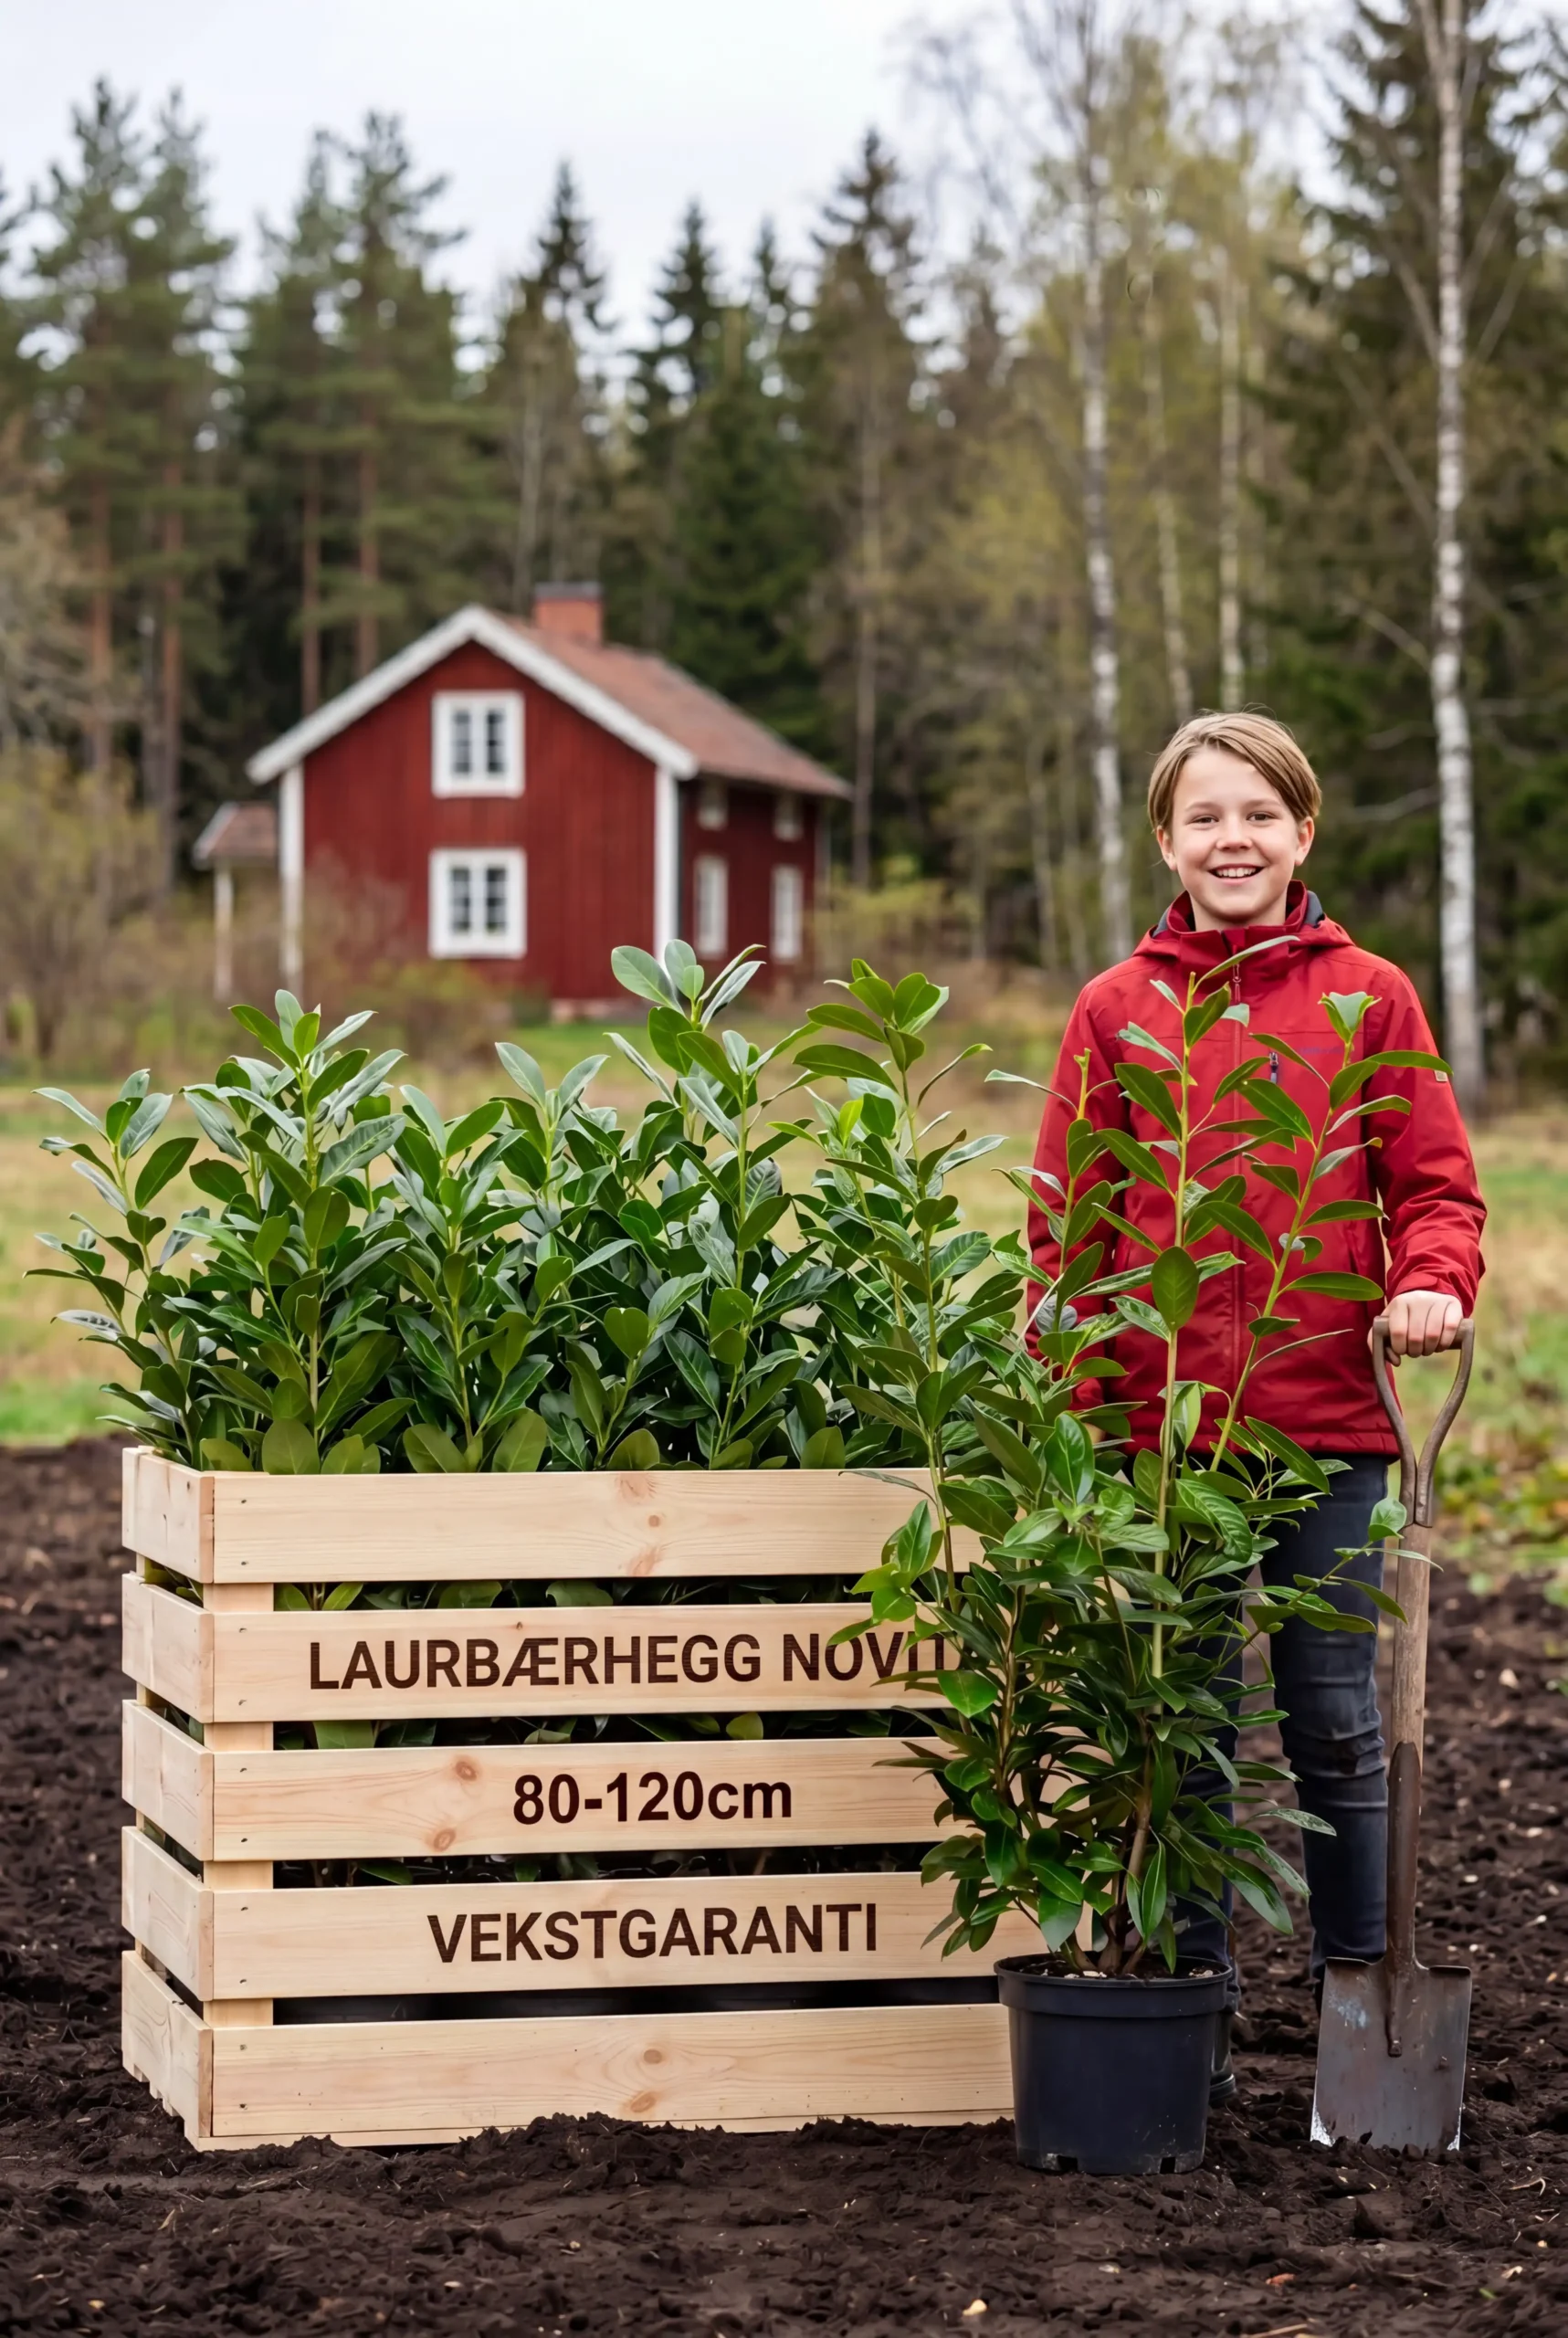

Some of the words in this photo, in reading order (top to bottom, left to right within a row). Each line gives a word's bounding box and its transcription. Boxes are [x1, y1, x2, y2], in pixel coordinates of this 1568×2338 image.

[310, 1634, 761, 1690] LAURBÆRHEGG
[783, 1631, 958, 1681] NOVIT
[513, 1771, 792, 1825] 80-120cm
[427, 1903, 877, 1963] VEKSTGARANTI
